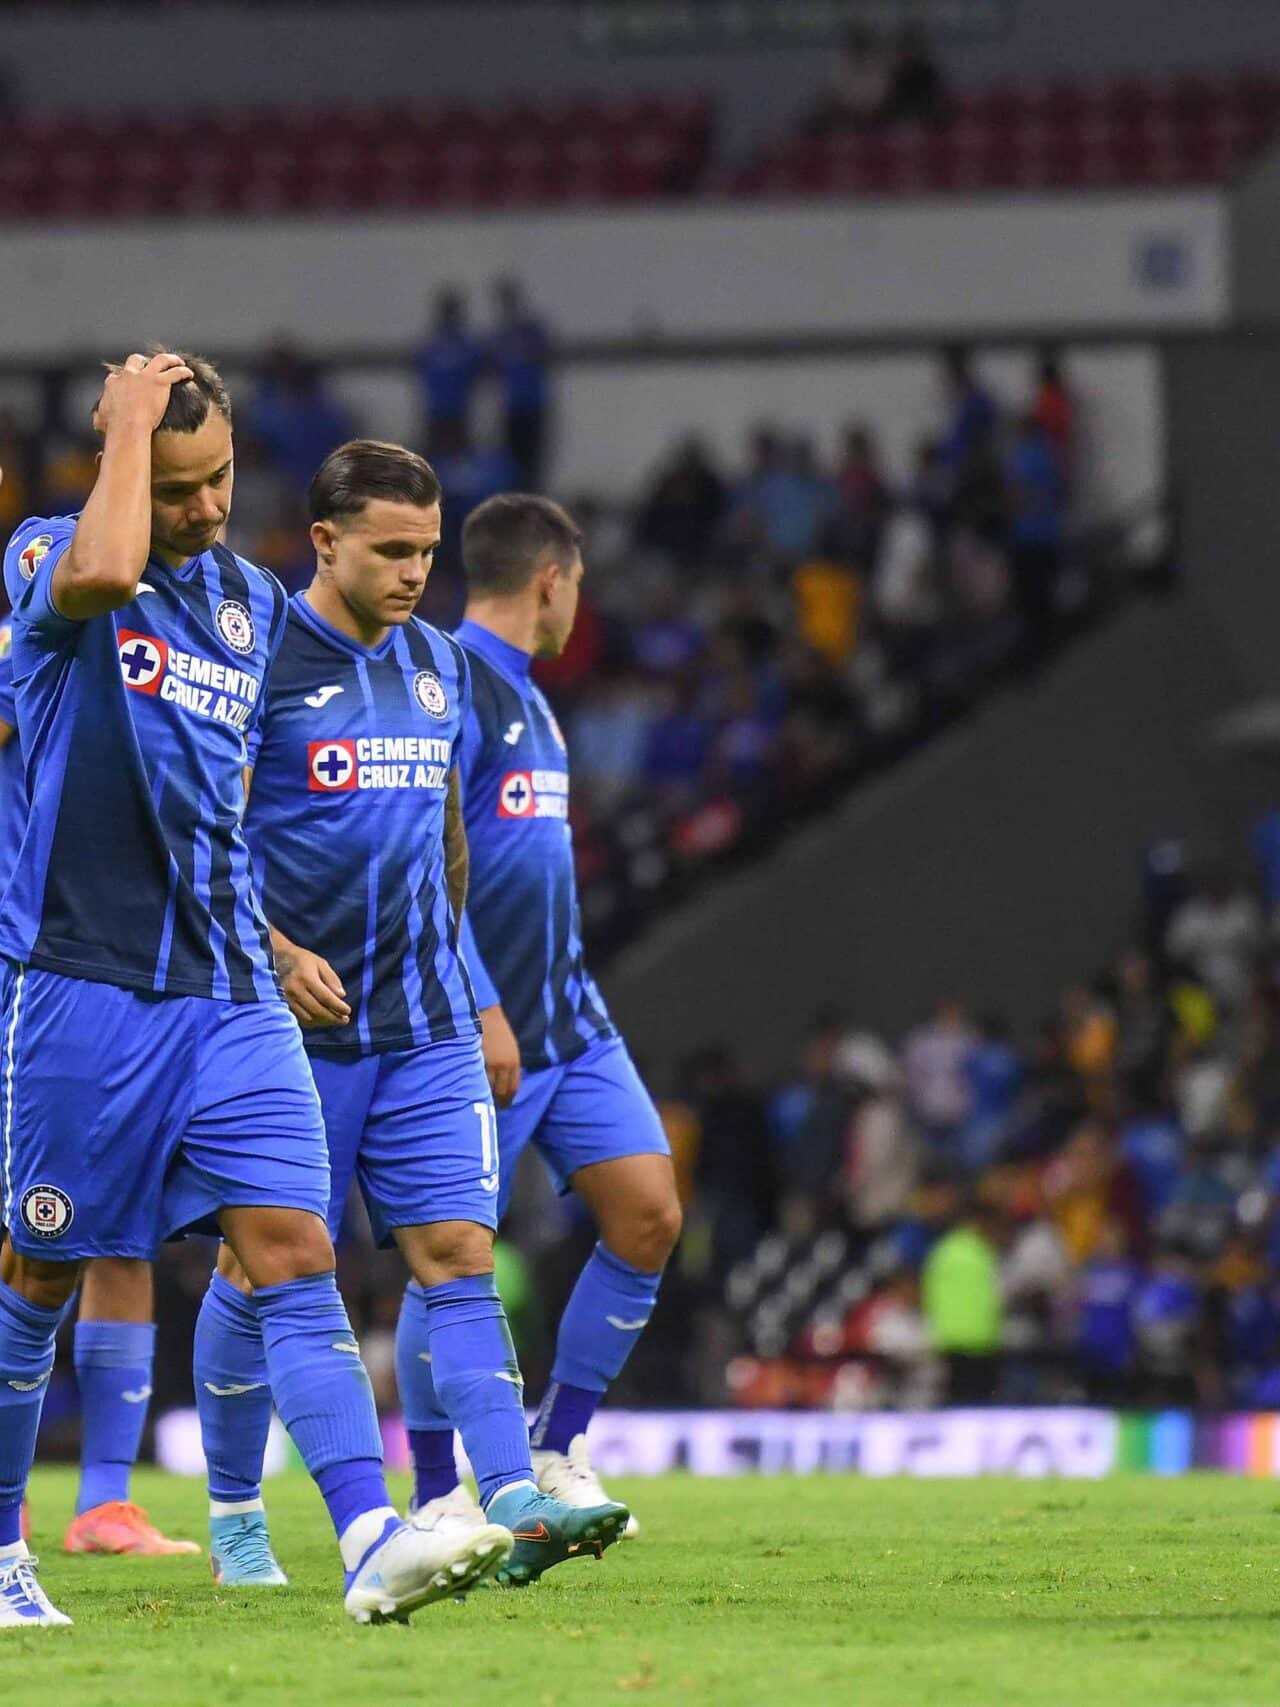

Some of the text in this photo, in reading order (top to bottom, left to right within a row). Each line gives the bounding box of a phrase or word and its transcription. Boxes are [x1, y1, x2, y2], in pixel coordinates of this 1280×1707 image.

[167, 647, 257, 704] CEMENTO
[159, 674, 252, 732] CRUZ AZUL
[356, 737, 451, 763] CEMENTO
[357, 764, 448, 790] CRUZ AZUL
